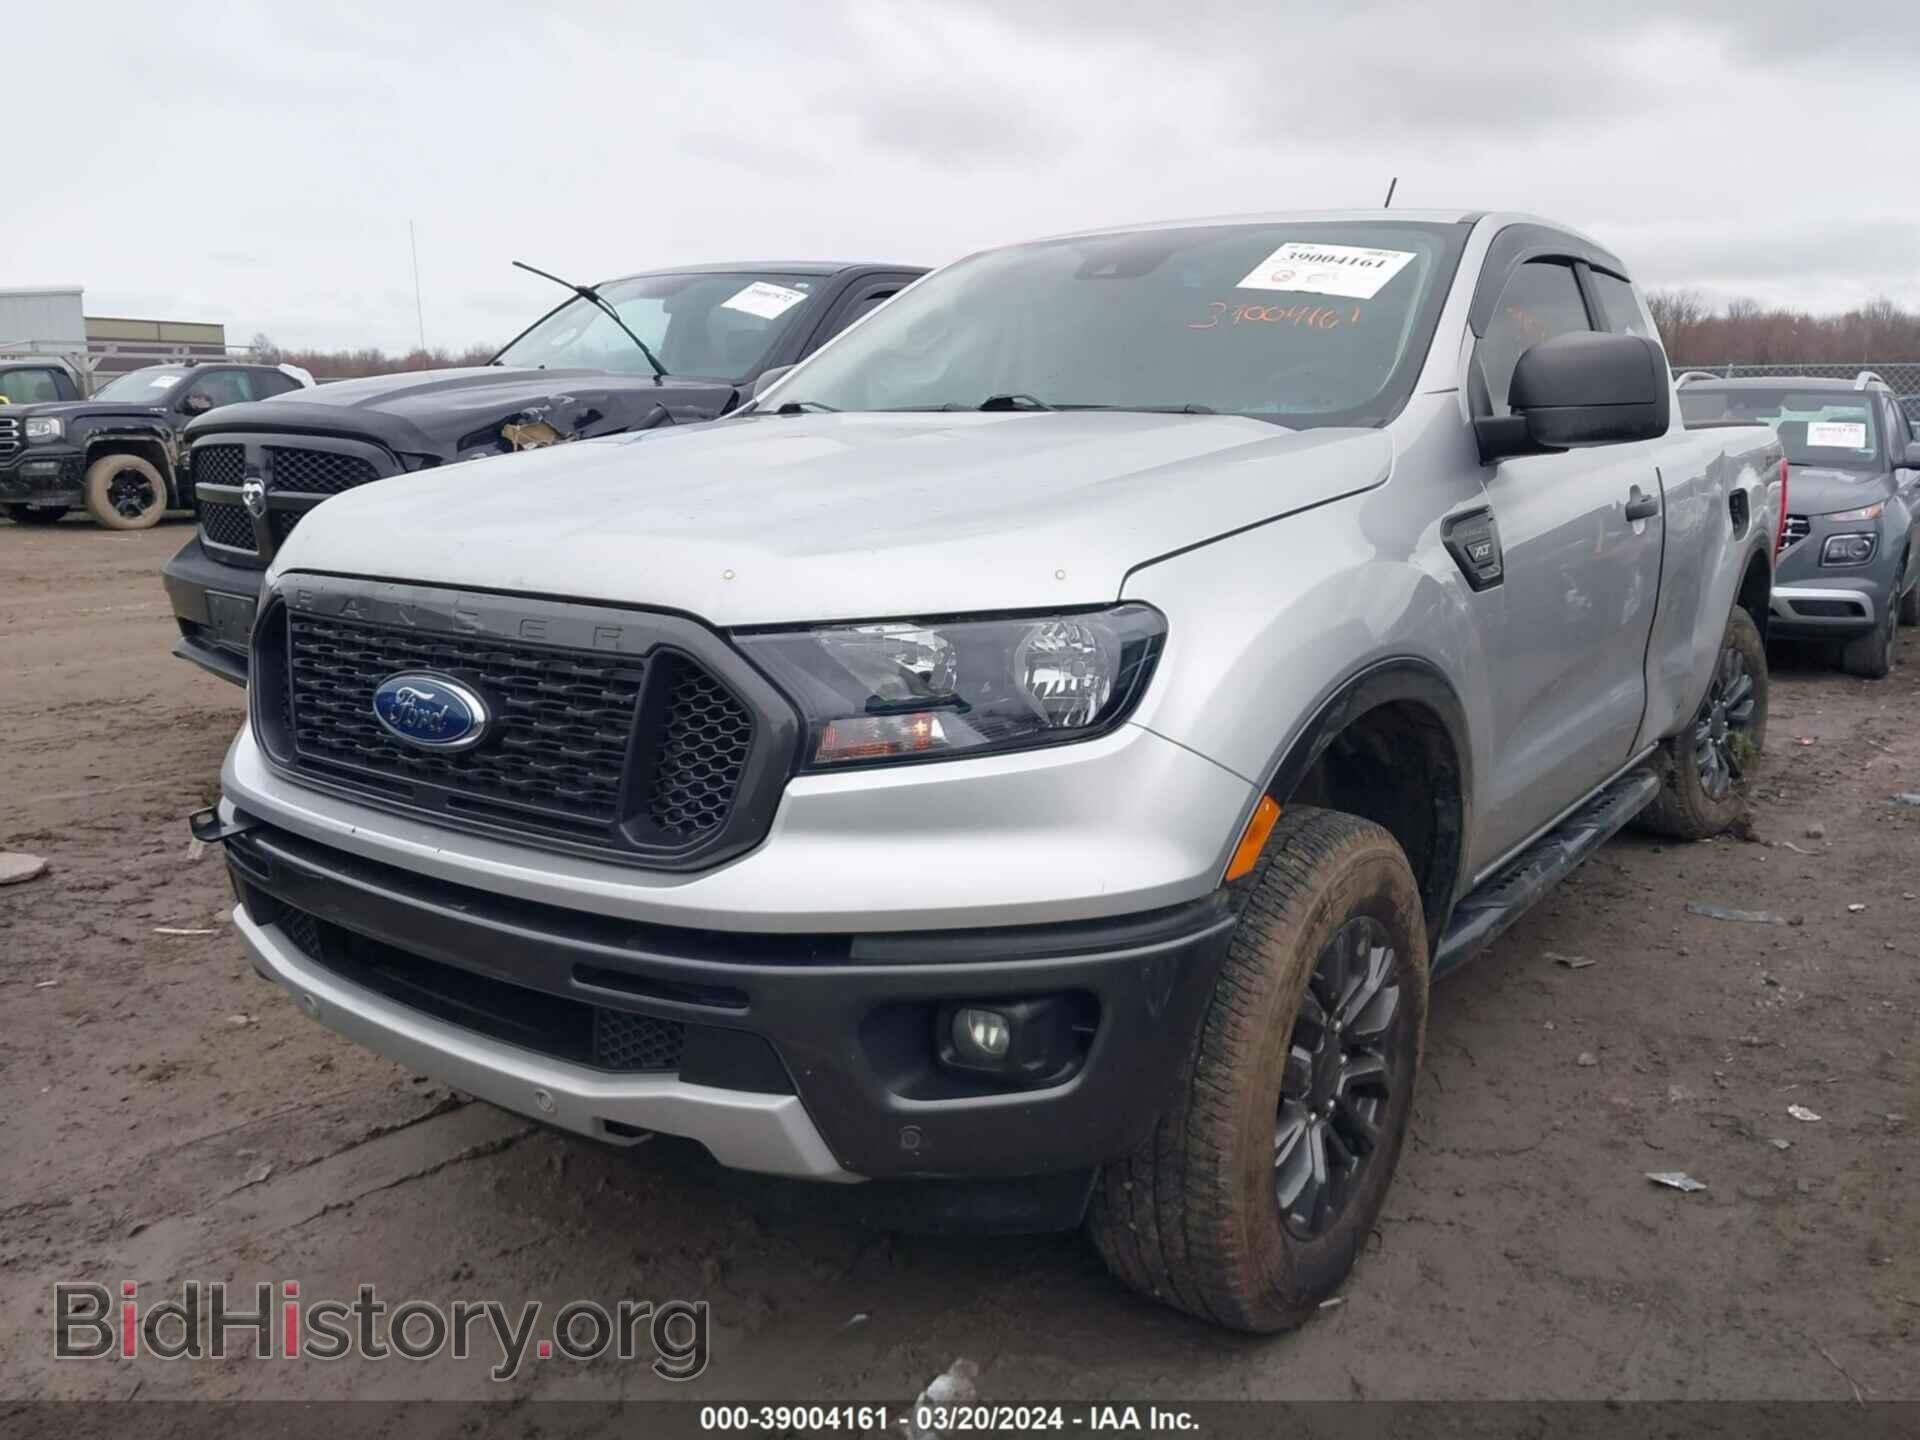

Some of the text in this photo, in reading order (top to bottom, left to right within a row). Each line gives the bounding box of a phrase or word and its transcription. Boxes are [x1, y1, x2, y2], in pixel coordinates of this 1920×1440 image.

[1280, 251, 1387, 269] 39004161
[296, 588, 626, 651] RANGER
[389, 686, 449, 732] Ford
